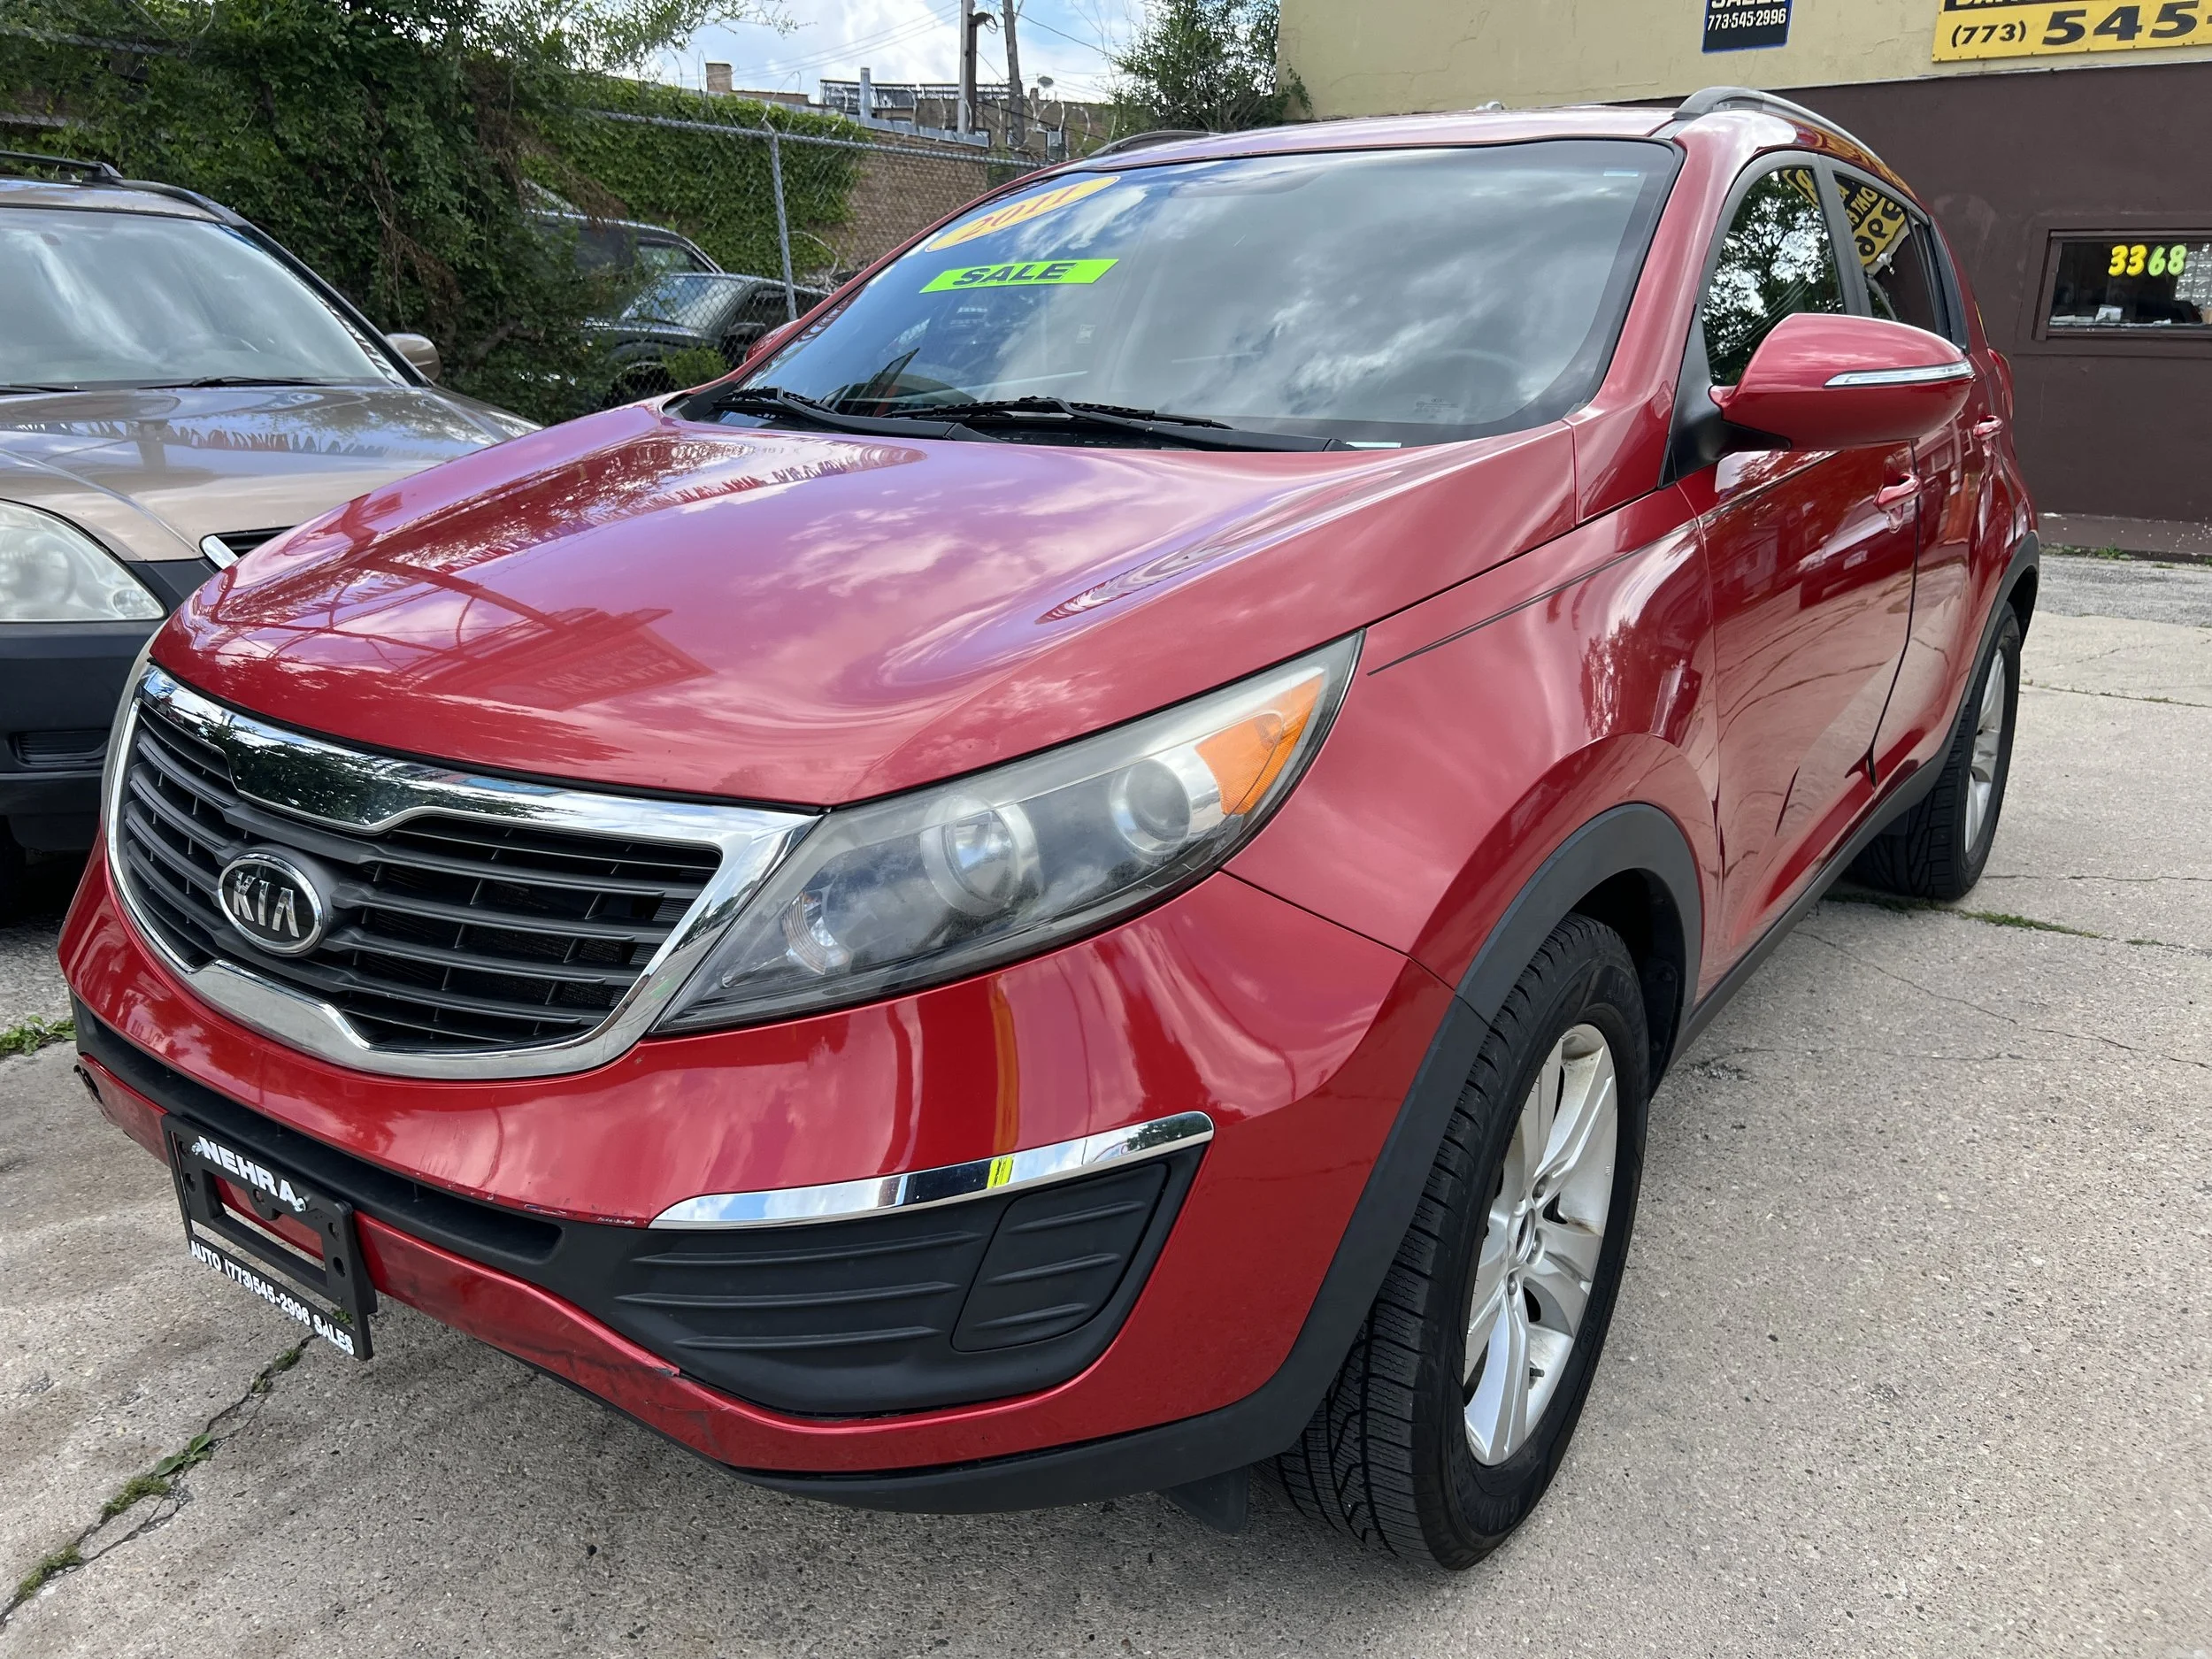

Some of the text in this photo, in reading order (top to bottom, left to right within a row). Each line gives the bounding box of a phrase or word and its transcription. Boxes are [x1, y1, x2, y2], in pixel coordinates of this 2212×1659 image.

[1951, 20, 2026, 48] (773)
[957, 185, 1081, 242] 2011
[952, 262, 1077, 286] SALE
[2108, 244, 2187, 276] 3368
[234, 870, 300, 938] KIA
[198, 1135, 301, 1204] NEHRA
[190, 1240, 222, 1271] AUTO
[313, 1314, 354, 1356] SALES
